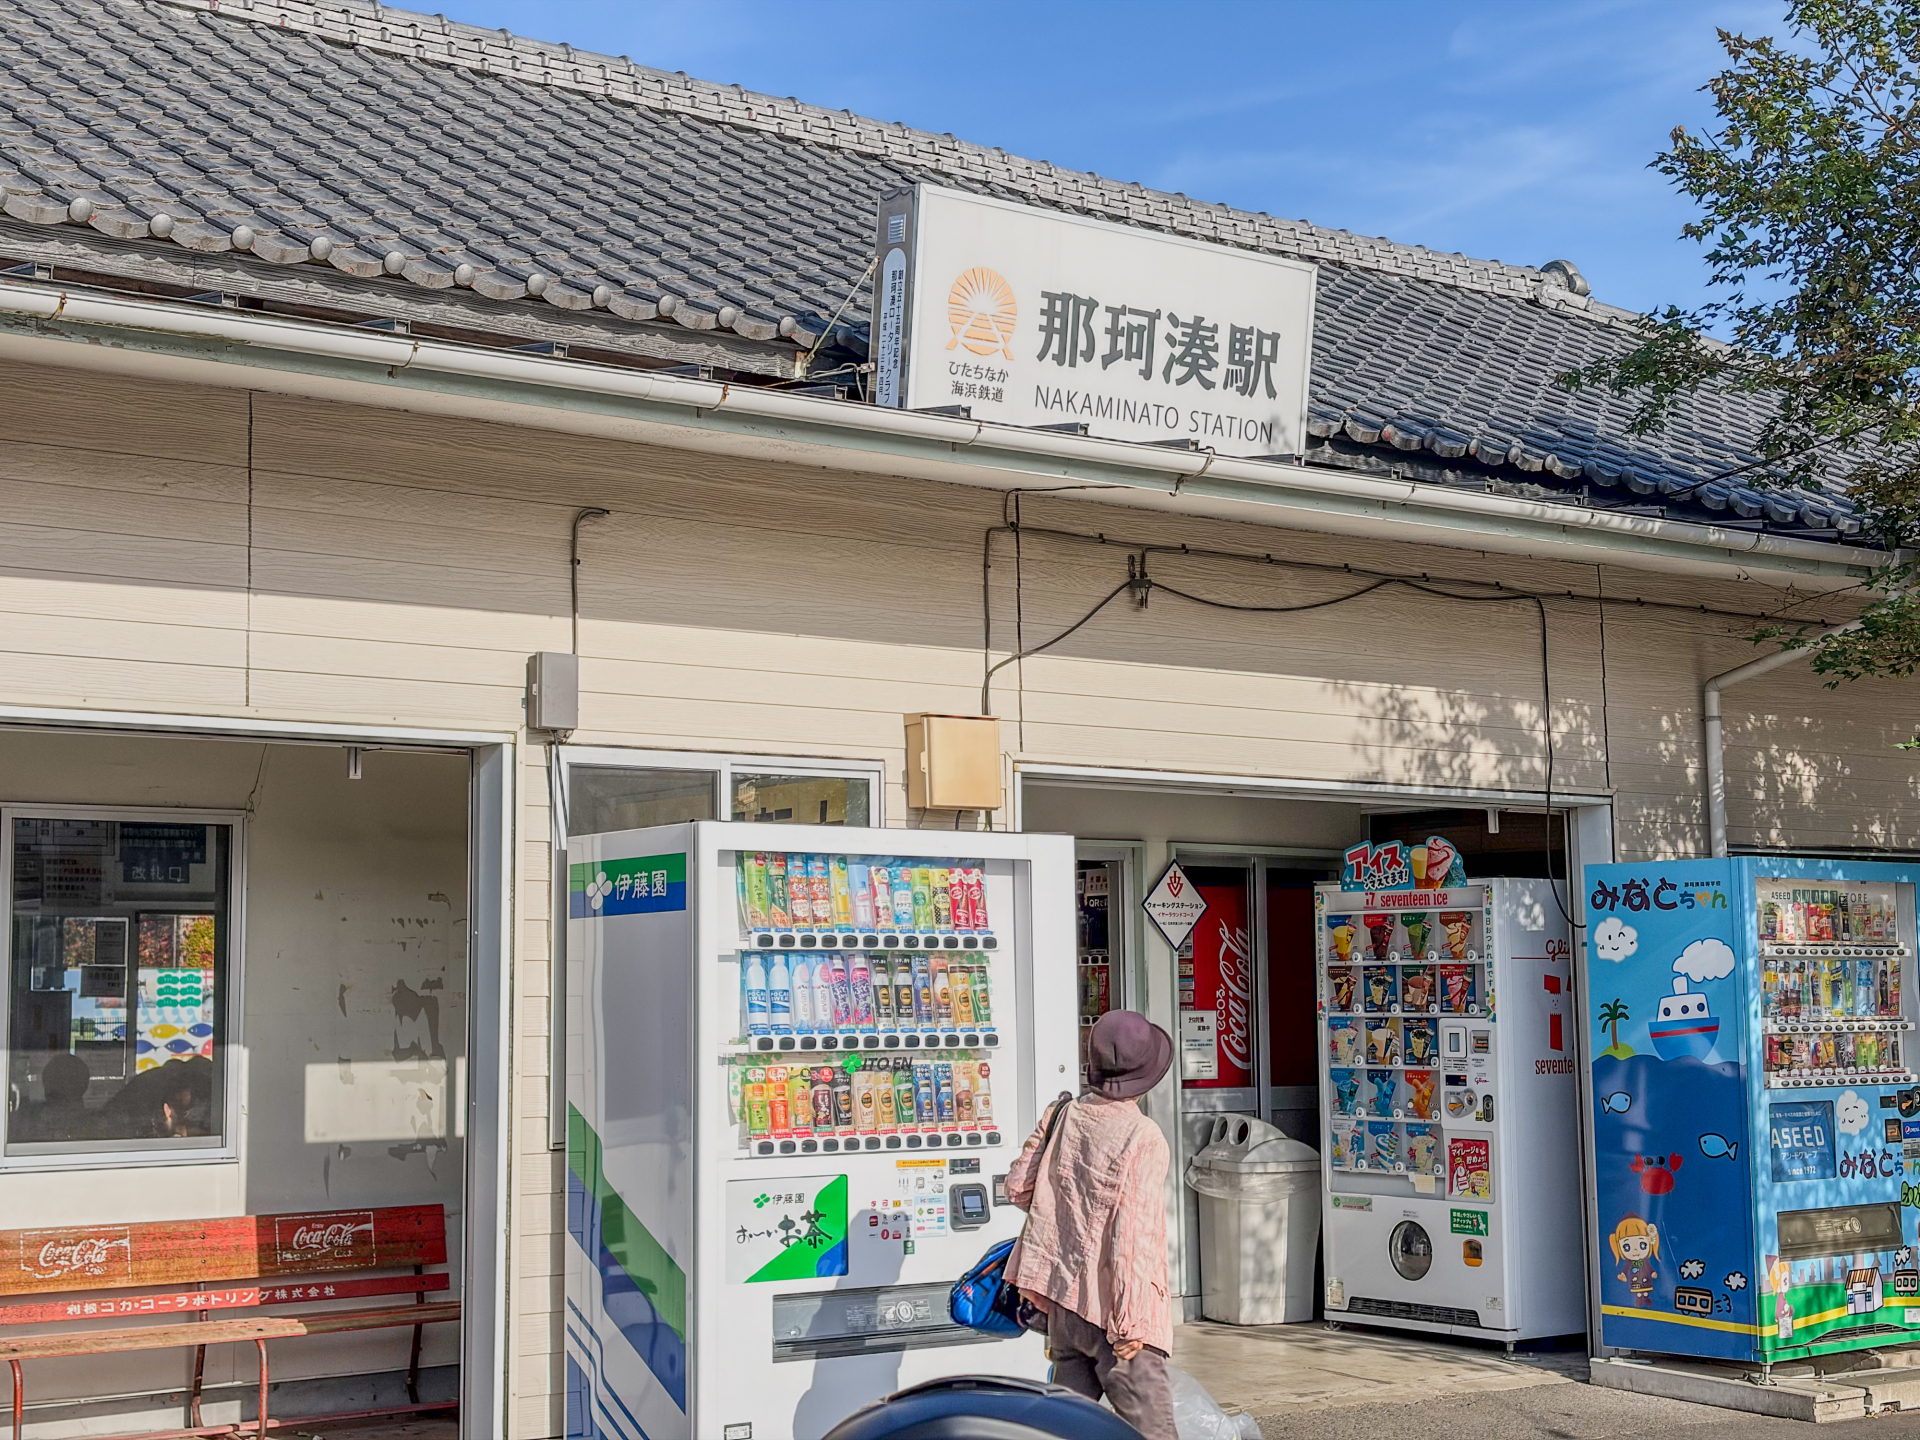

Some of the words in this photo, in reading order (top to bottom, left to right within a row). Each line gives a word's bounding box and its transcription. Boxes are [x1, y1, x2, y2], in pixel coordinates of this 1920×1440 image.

[1036, 290, 1281, 400] 那珂湊駅
[948, 360, 1010, 384] ひたちなか
[951, 381, 1004, 403] 海浜鉄道
[1035, 385, 1179, 431] NAKAMINATO
[1189, 411, 1273, 444] STATION
[1346, 844, 1404, 881] アイス
[614, 869, 668, 901] 伊藤園
[1590, 876, 1727, 912] みなとちゃん
[1771, 892, 1790, 900] ASEED
[1146, 902, 1204, 910] ウォーキングステーション
[1381, 891, 1431, 907] seventeen
[1433, 891, 1448, 906] ice
[892, 1056, 913, 1070] EN
[1771, 1125, 1825, 1149] ASEED
[772, 1193, 805, 1205] 伊藤園
